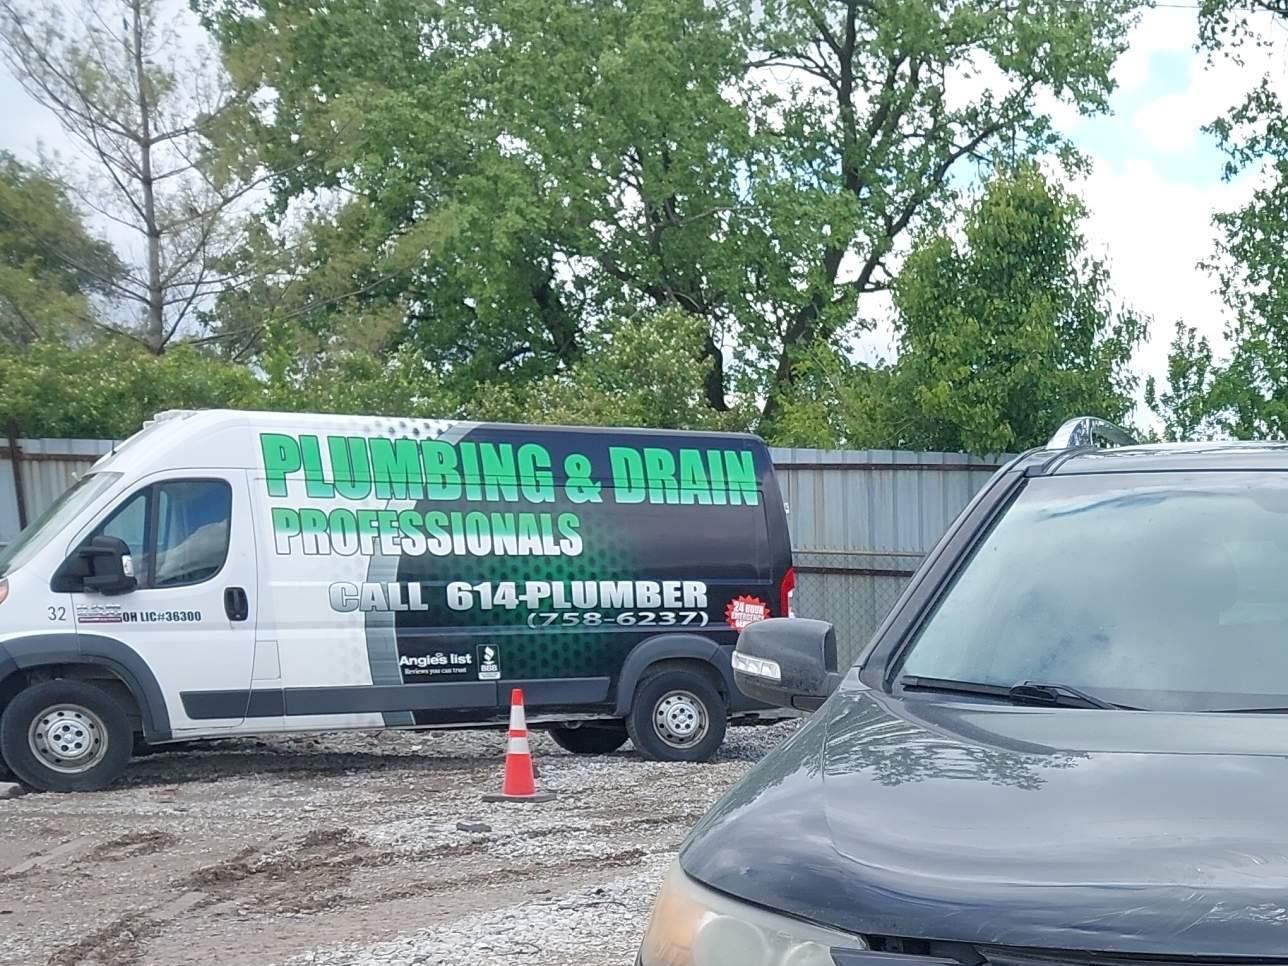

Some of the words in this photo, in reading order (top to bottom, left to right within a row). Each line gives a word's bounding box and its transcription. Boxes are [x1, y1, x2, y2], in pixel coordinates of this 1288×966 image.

[260, 433, 554, 504] PLUMBING
[564, 455, 603, 503] &
[609, 446, 760, 506] DRAIN
[271, 507, 583, 557] PROFESSIONALS
[328, 581, 429, 613] CALL
[447, 580, 709, 611] 614-PLUMBER
[47, 606, 67, 621] 32
[122, 611, 138, 623] OH
[526, 612, 710, 629] (758-6237)
[450, 653, 472, 664] list
